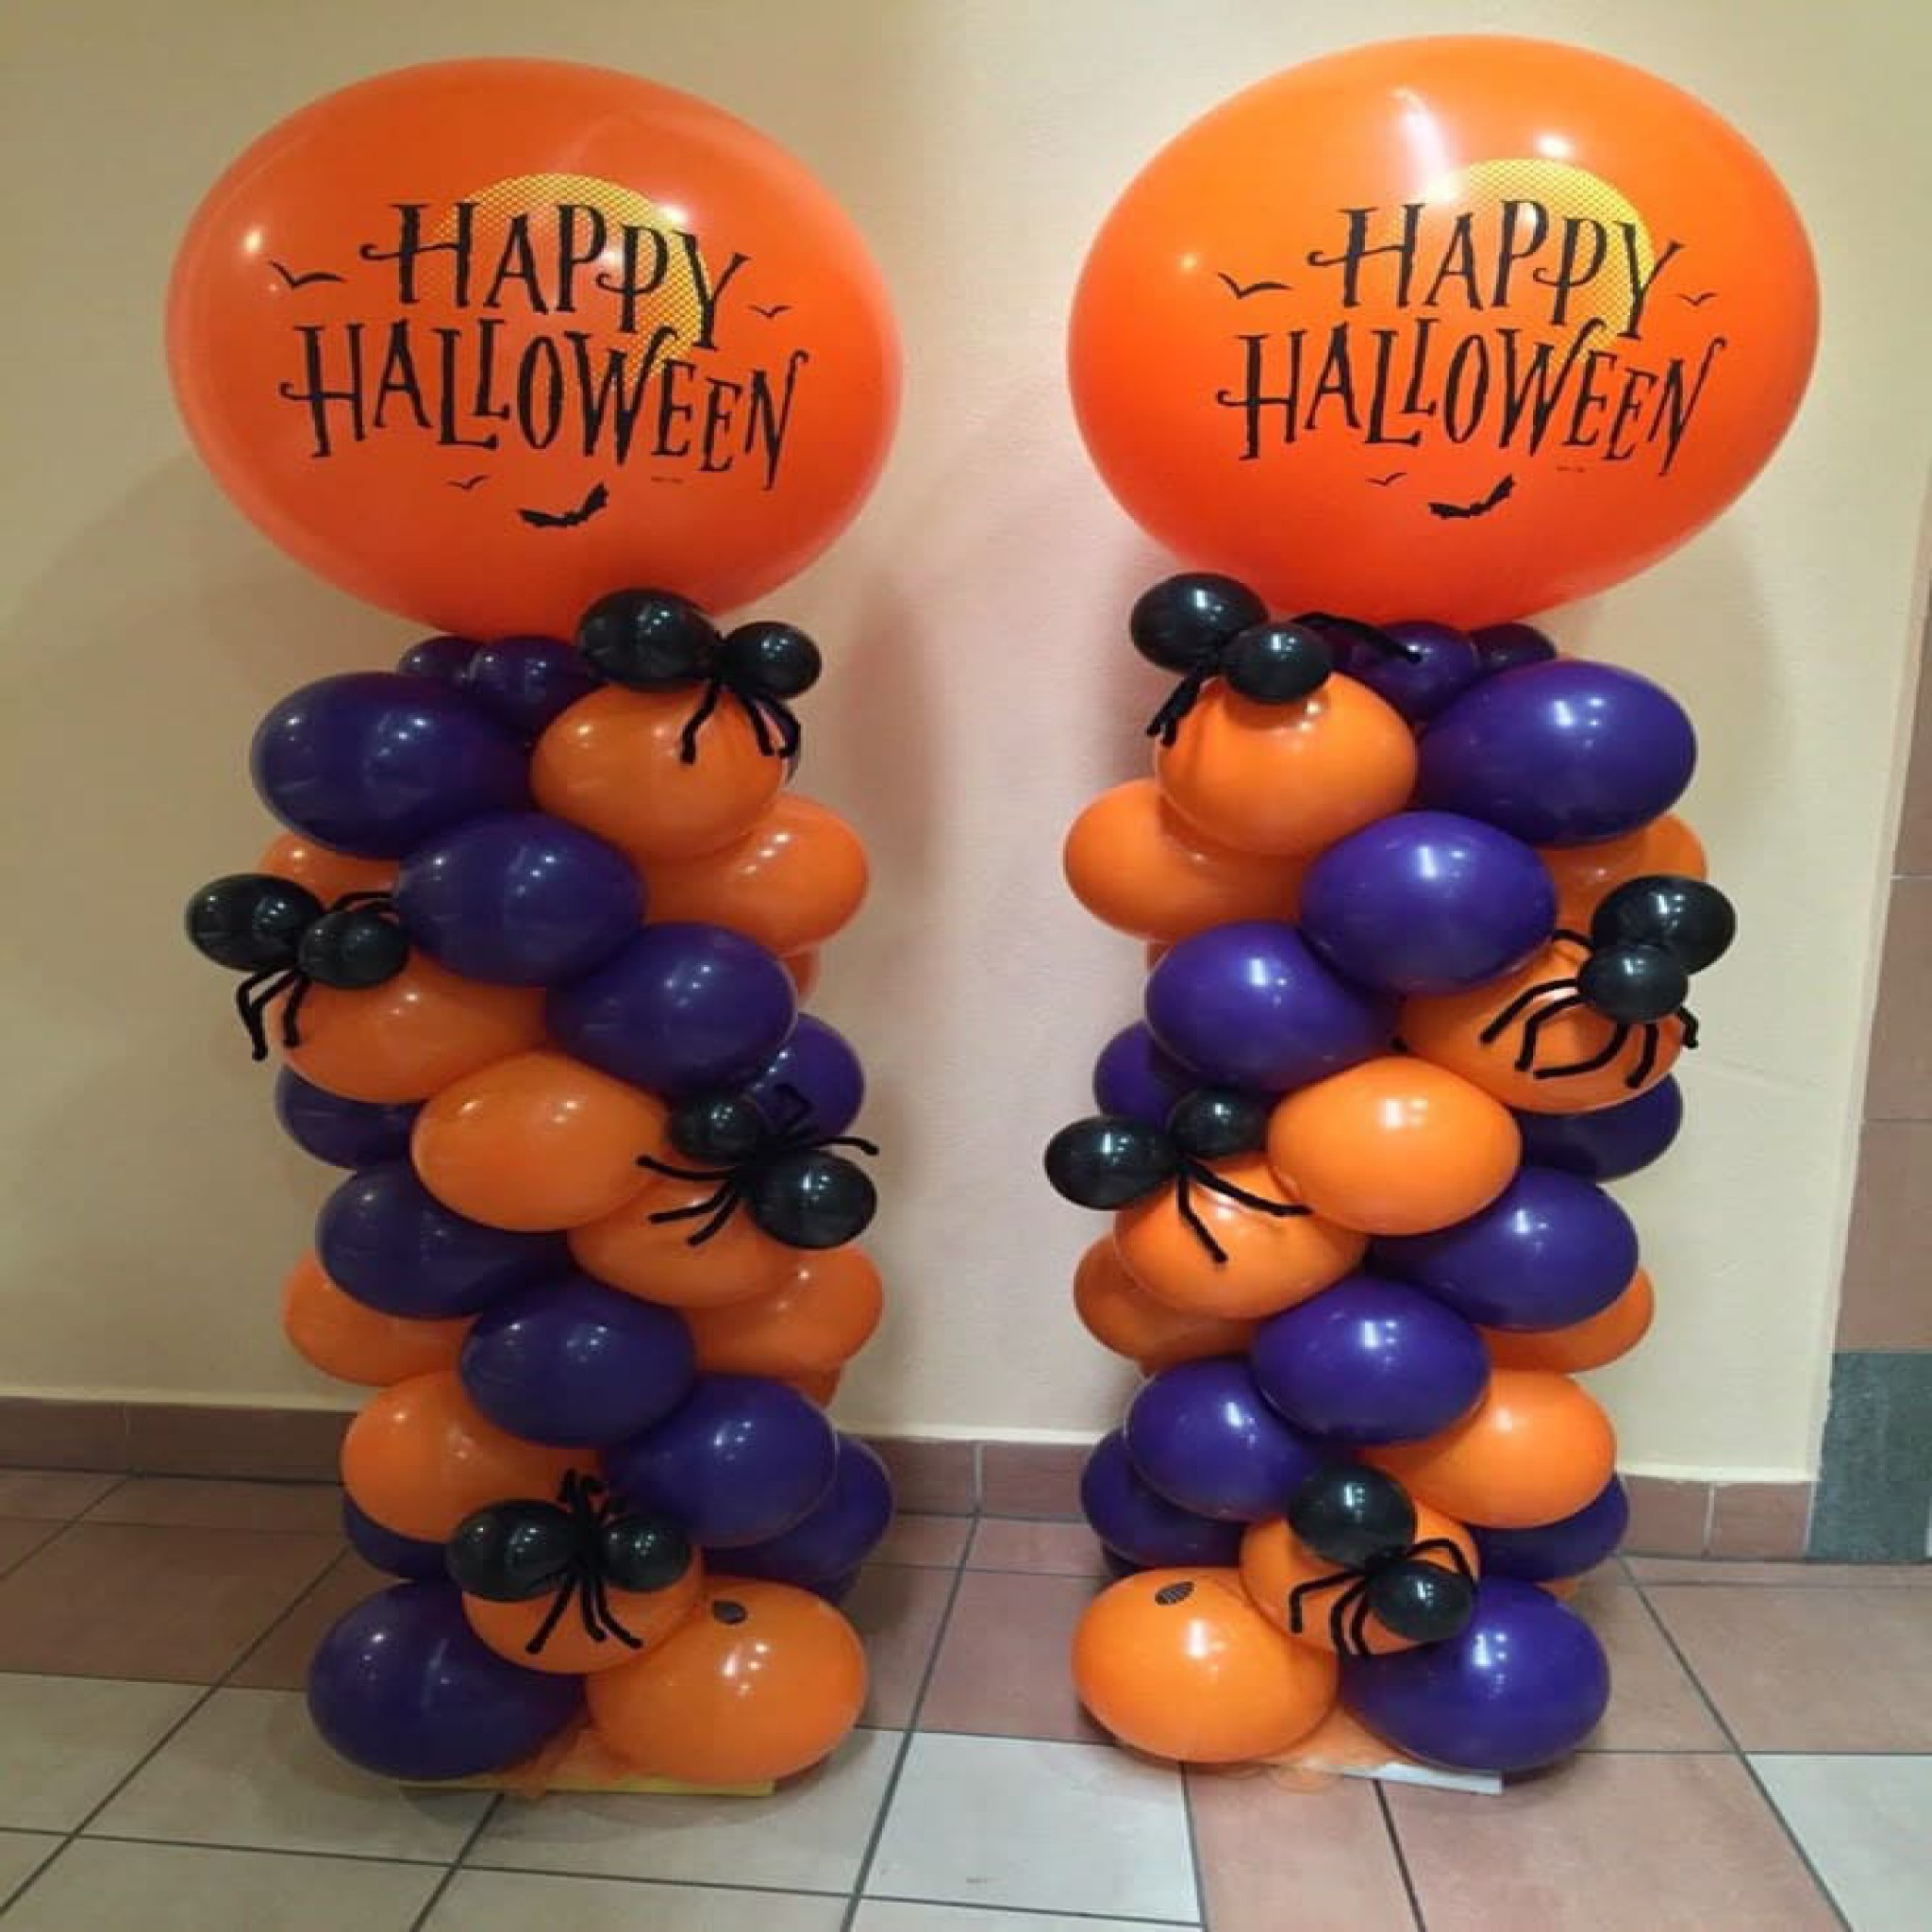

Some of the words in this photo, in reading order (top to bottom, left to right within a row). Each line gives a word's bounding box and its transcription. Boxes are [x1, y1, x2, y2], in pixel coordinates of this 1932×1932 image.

[359, 202, 751, 351] HAPPY
[1307, 200, 1686, 340] HAPPY
[279, 318, 809, 491] HALLOWEEN
[1217, 317, 1727, 476] HALLOWEEN
